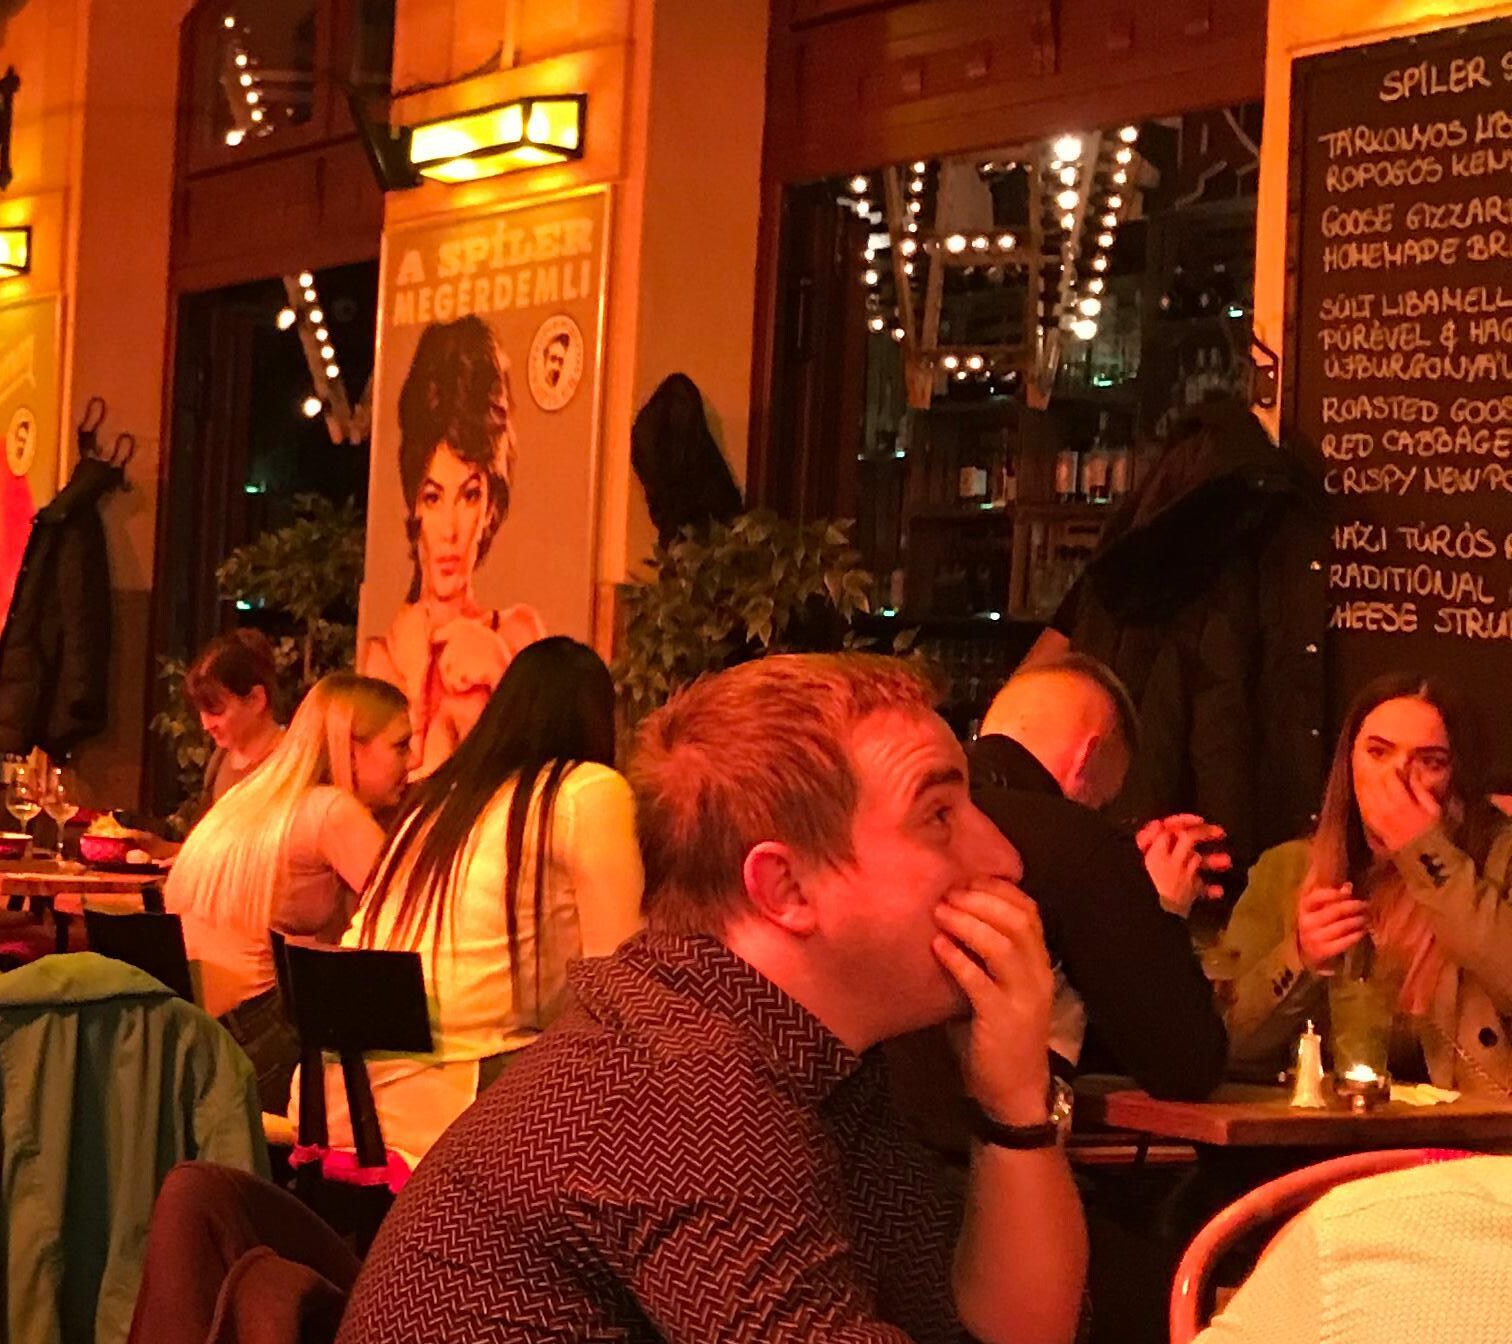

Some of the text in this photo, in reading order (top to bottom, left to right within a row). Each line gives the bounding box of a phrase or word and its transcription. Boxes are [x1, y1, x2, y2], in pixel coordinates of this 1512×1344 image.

[1452, 147, 1512, 176] KEN
[1322, 196, 1512, 237] GOOSE GIZZAR
[396, 218, 594, 286] A SPÍLER
[1323, 237, 1461, 272] HOMEMADE
[393, 258, 592, 326] MEGÉRDEMLI
[1322, 395, 1438, 423] ROASTED
[1322, 425, 1512, 460] RED CABBAGE
[1324, 464, 1417, 495] CRISPY
[1424, 466, 1481, 494] NEW
[1330, 563, 1495, 604] RADITIONAL
[1329, 601, 1512, 640] HEESE STRU
